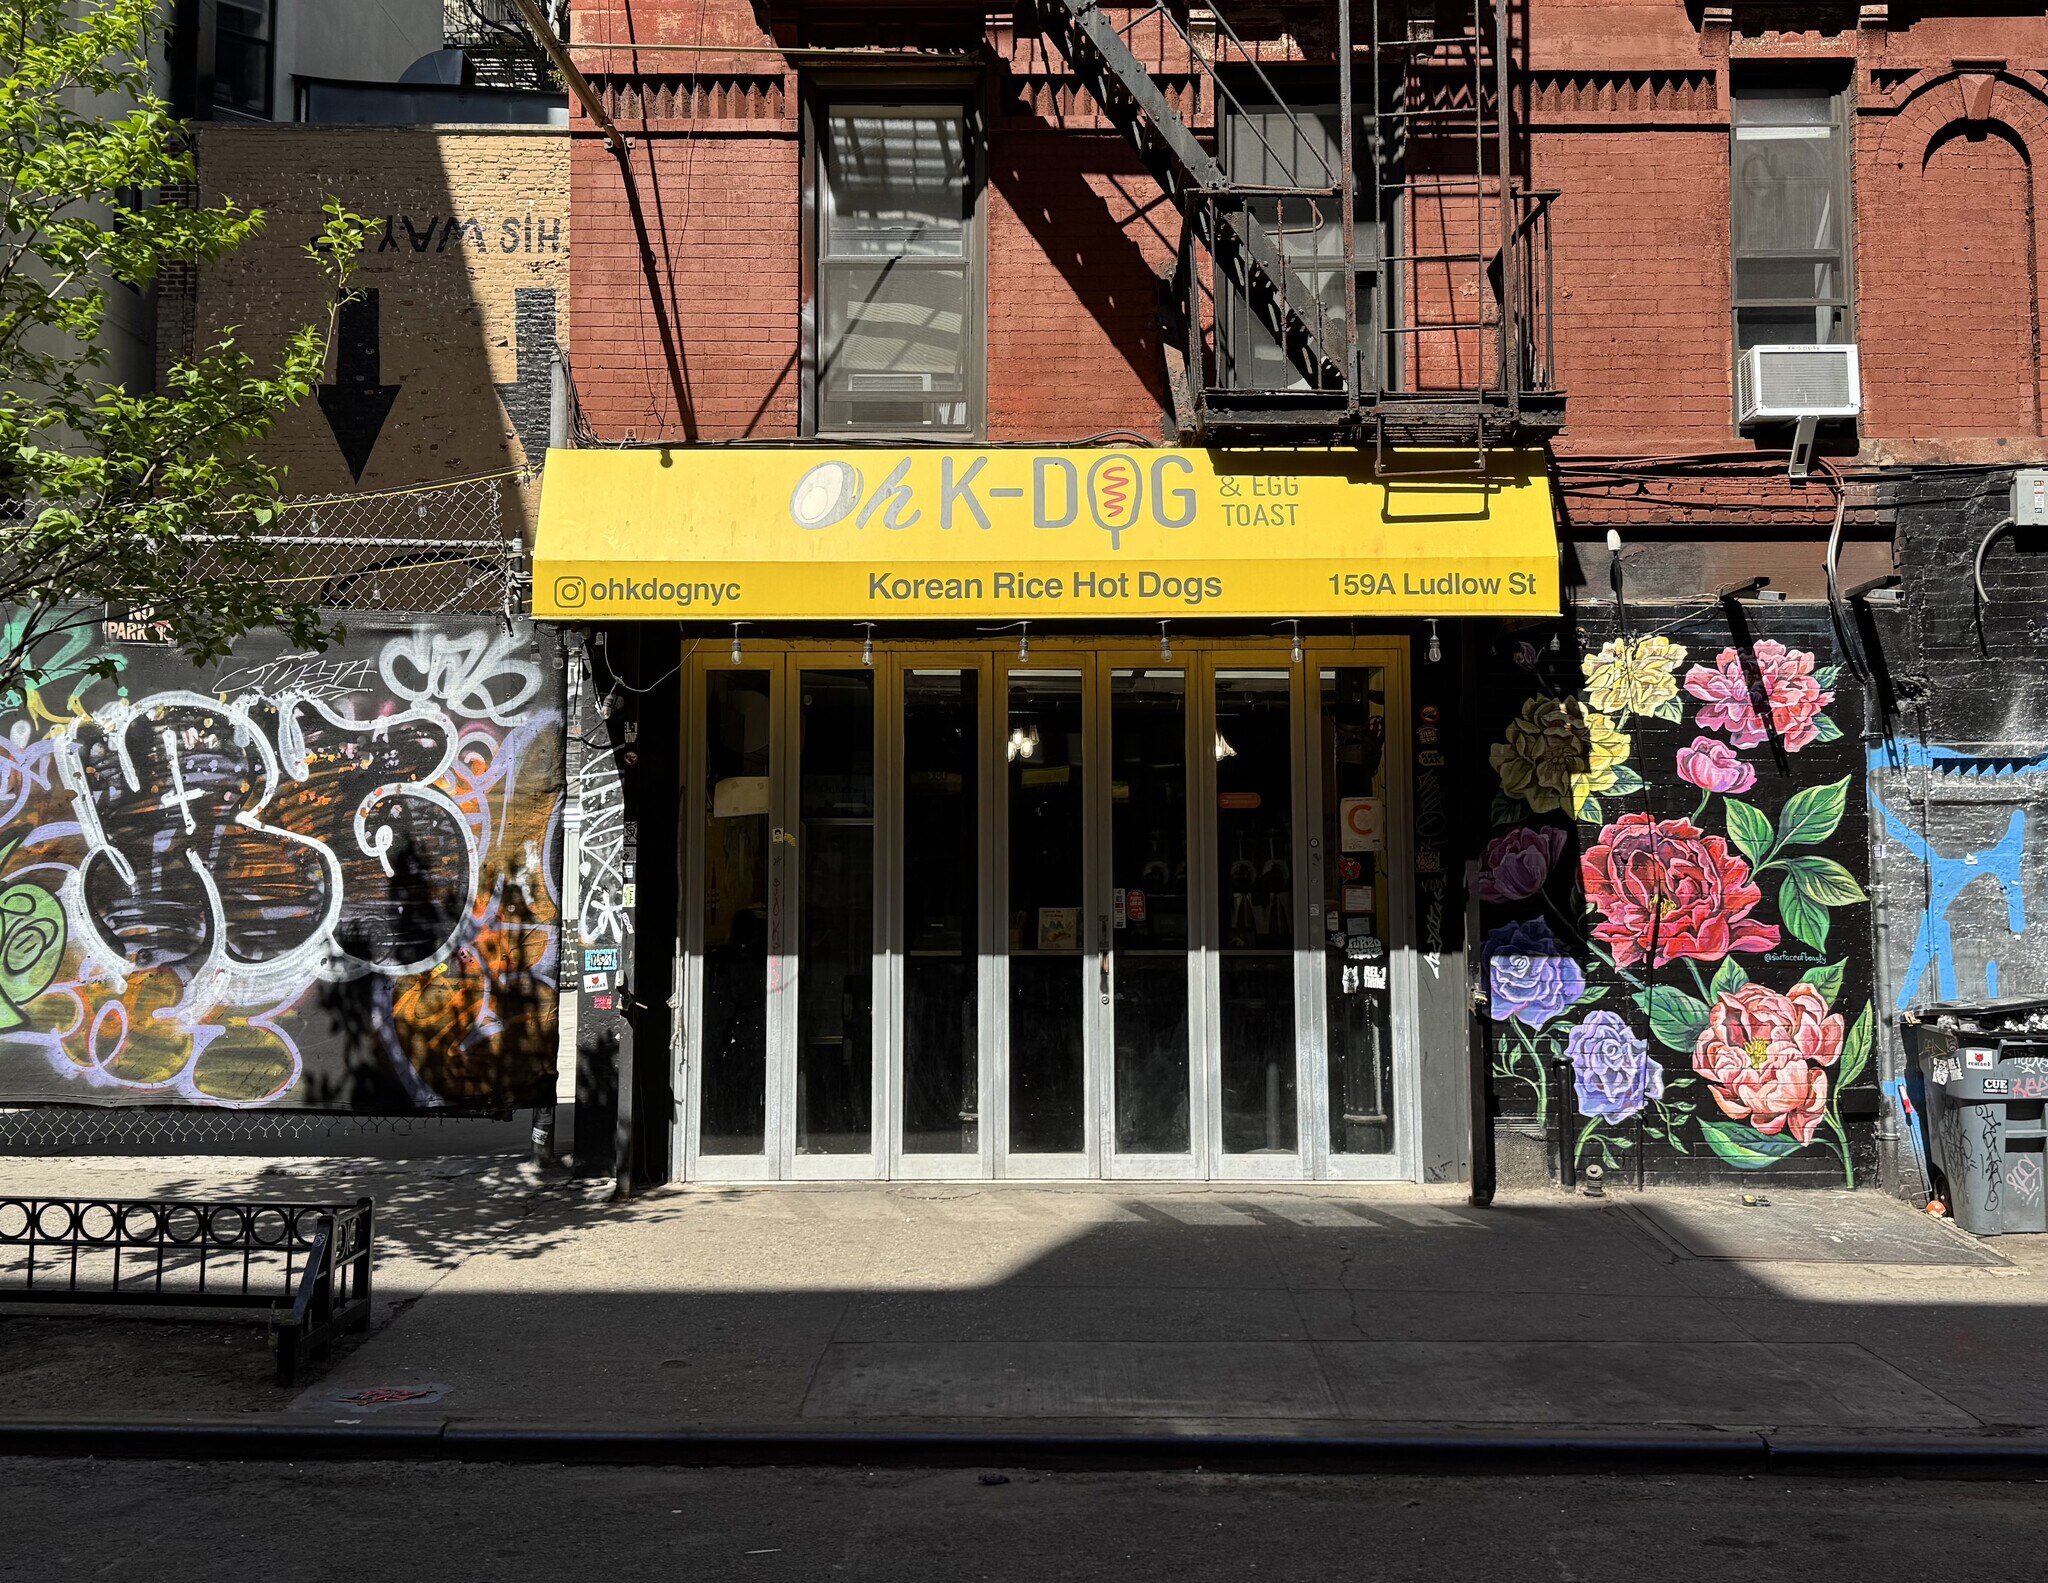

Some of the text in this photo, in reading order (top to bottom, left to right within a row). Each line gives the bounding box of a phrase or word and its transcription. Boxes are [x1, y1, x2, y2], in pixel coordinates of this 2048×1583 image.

[377, 215, 487, 254] WAY
[1219, 475, 1299, 497] & EGG
[789, 453, 1197, 550] Oh K-DOG
[1220, 503, 1299, 527] TOAST
[591, 577, 741, 606] ohkdognyc
[869, 571, 1222, 605] Korean Rice Hot Dogs
[1328, 571, 1537, 596] 159A Ludlow St
[1347, 804, 1374, 835] C
[1984, 1079, 2008, 1089] CUE
